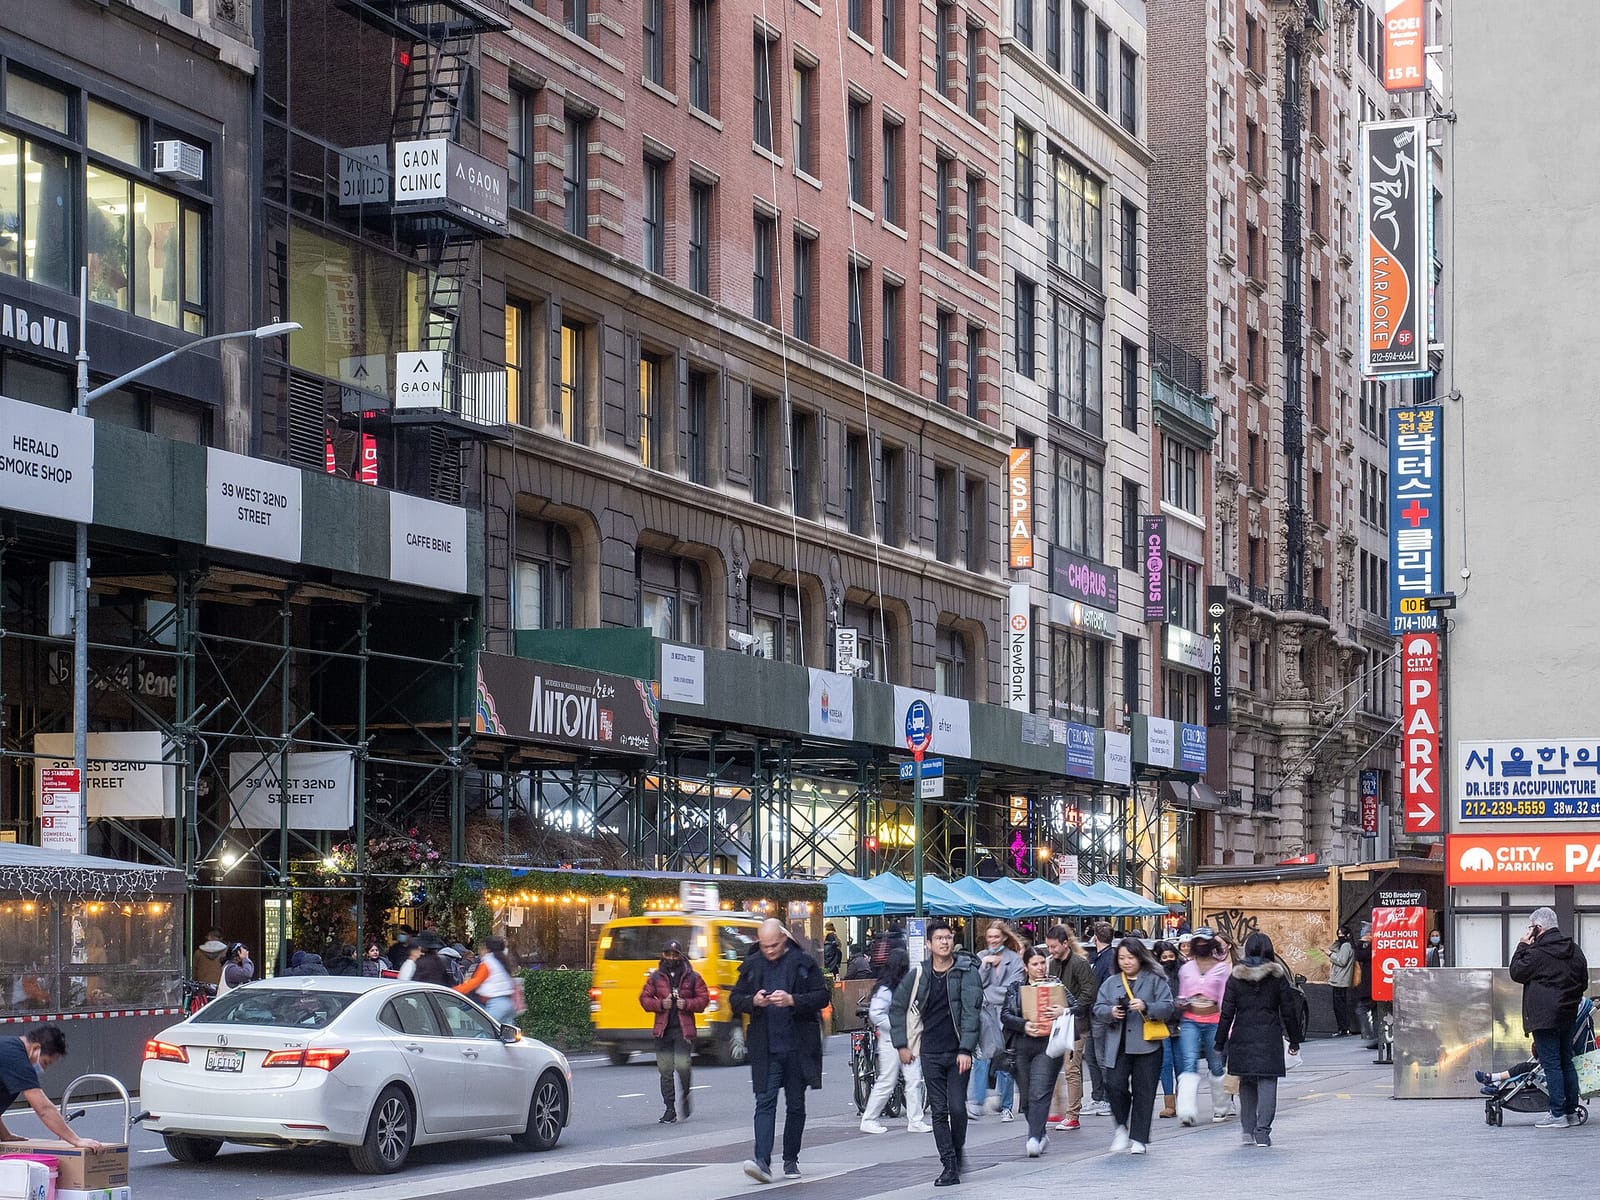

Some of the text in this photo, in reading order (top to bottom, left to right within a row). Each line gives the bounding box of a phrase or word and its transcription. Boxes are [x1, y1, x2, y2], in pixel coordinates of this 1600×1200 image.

[1388, 17, 1420, 31] COEI
[1388, 66, 1419, 80] 15 FL
[404, 149, 438, 168] GAON
[400, 173, 441, 191] CLINIC
[468, 167, 500, 195] GAON
[1374, 257, 1390, 342] KARAOKE
[1399, 334, 1410, 342] 5F
[1372, 350, 1414, 362] 212-594-6644
[401, 382, 441, 392] GAON
[1398, 410, 1434, 422] 학생
[13, 435, 58, 458] HERALD
[0, 456, 72, 484] SMOKE SHOP
[222, 482, 287, 508] 39 WEST 32ND
[1011, 477, 1029, 538] SPA
[238, 507, 271, 526] STREET
[406, 533, 451, 552] CAFFE BENE
[1017, 556, 1029, 566] 5F
[1147, 534, 1163, 602] CHORUS
[1397, 529, 1432, 594] 클리닉
[1069, 564, 1106, 597] CHORUS
[1405, 600, 1416, 611] 10
[1013, 634, 1026, 702] NewBank
[1407, 658, 1432, 667] CITY
[529, 675, 598, 741] ANTOYA
[1408, 679, 1435, 793] PARK
[112, 761, 146, 771] 32ND
[901, 765, 913, 777] Q32
[87, 778, 124, 788] TREET
[302, 779, 336, 789] 32ND
[1513, 780, 1596, 795] ACCUPUNCTURE
[1466, 801, 1545, 816] 212-239-5559
[1554, 802, 1575, 814] 38w.
[1577, 801, 1588, 814] 32
[45, 817, 51, 827] 3
[1496, 846, 1541, 862] CITY
[1497, 862, 1554, 872] PARKING
[1377, 940, 1418, 949] SPECIAL
[1404, 958, 1418, 967] 29
